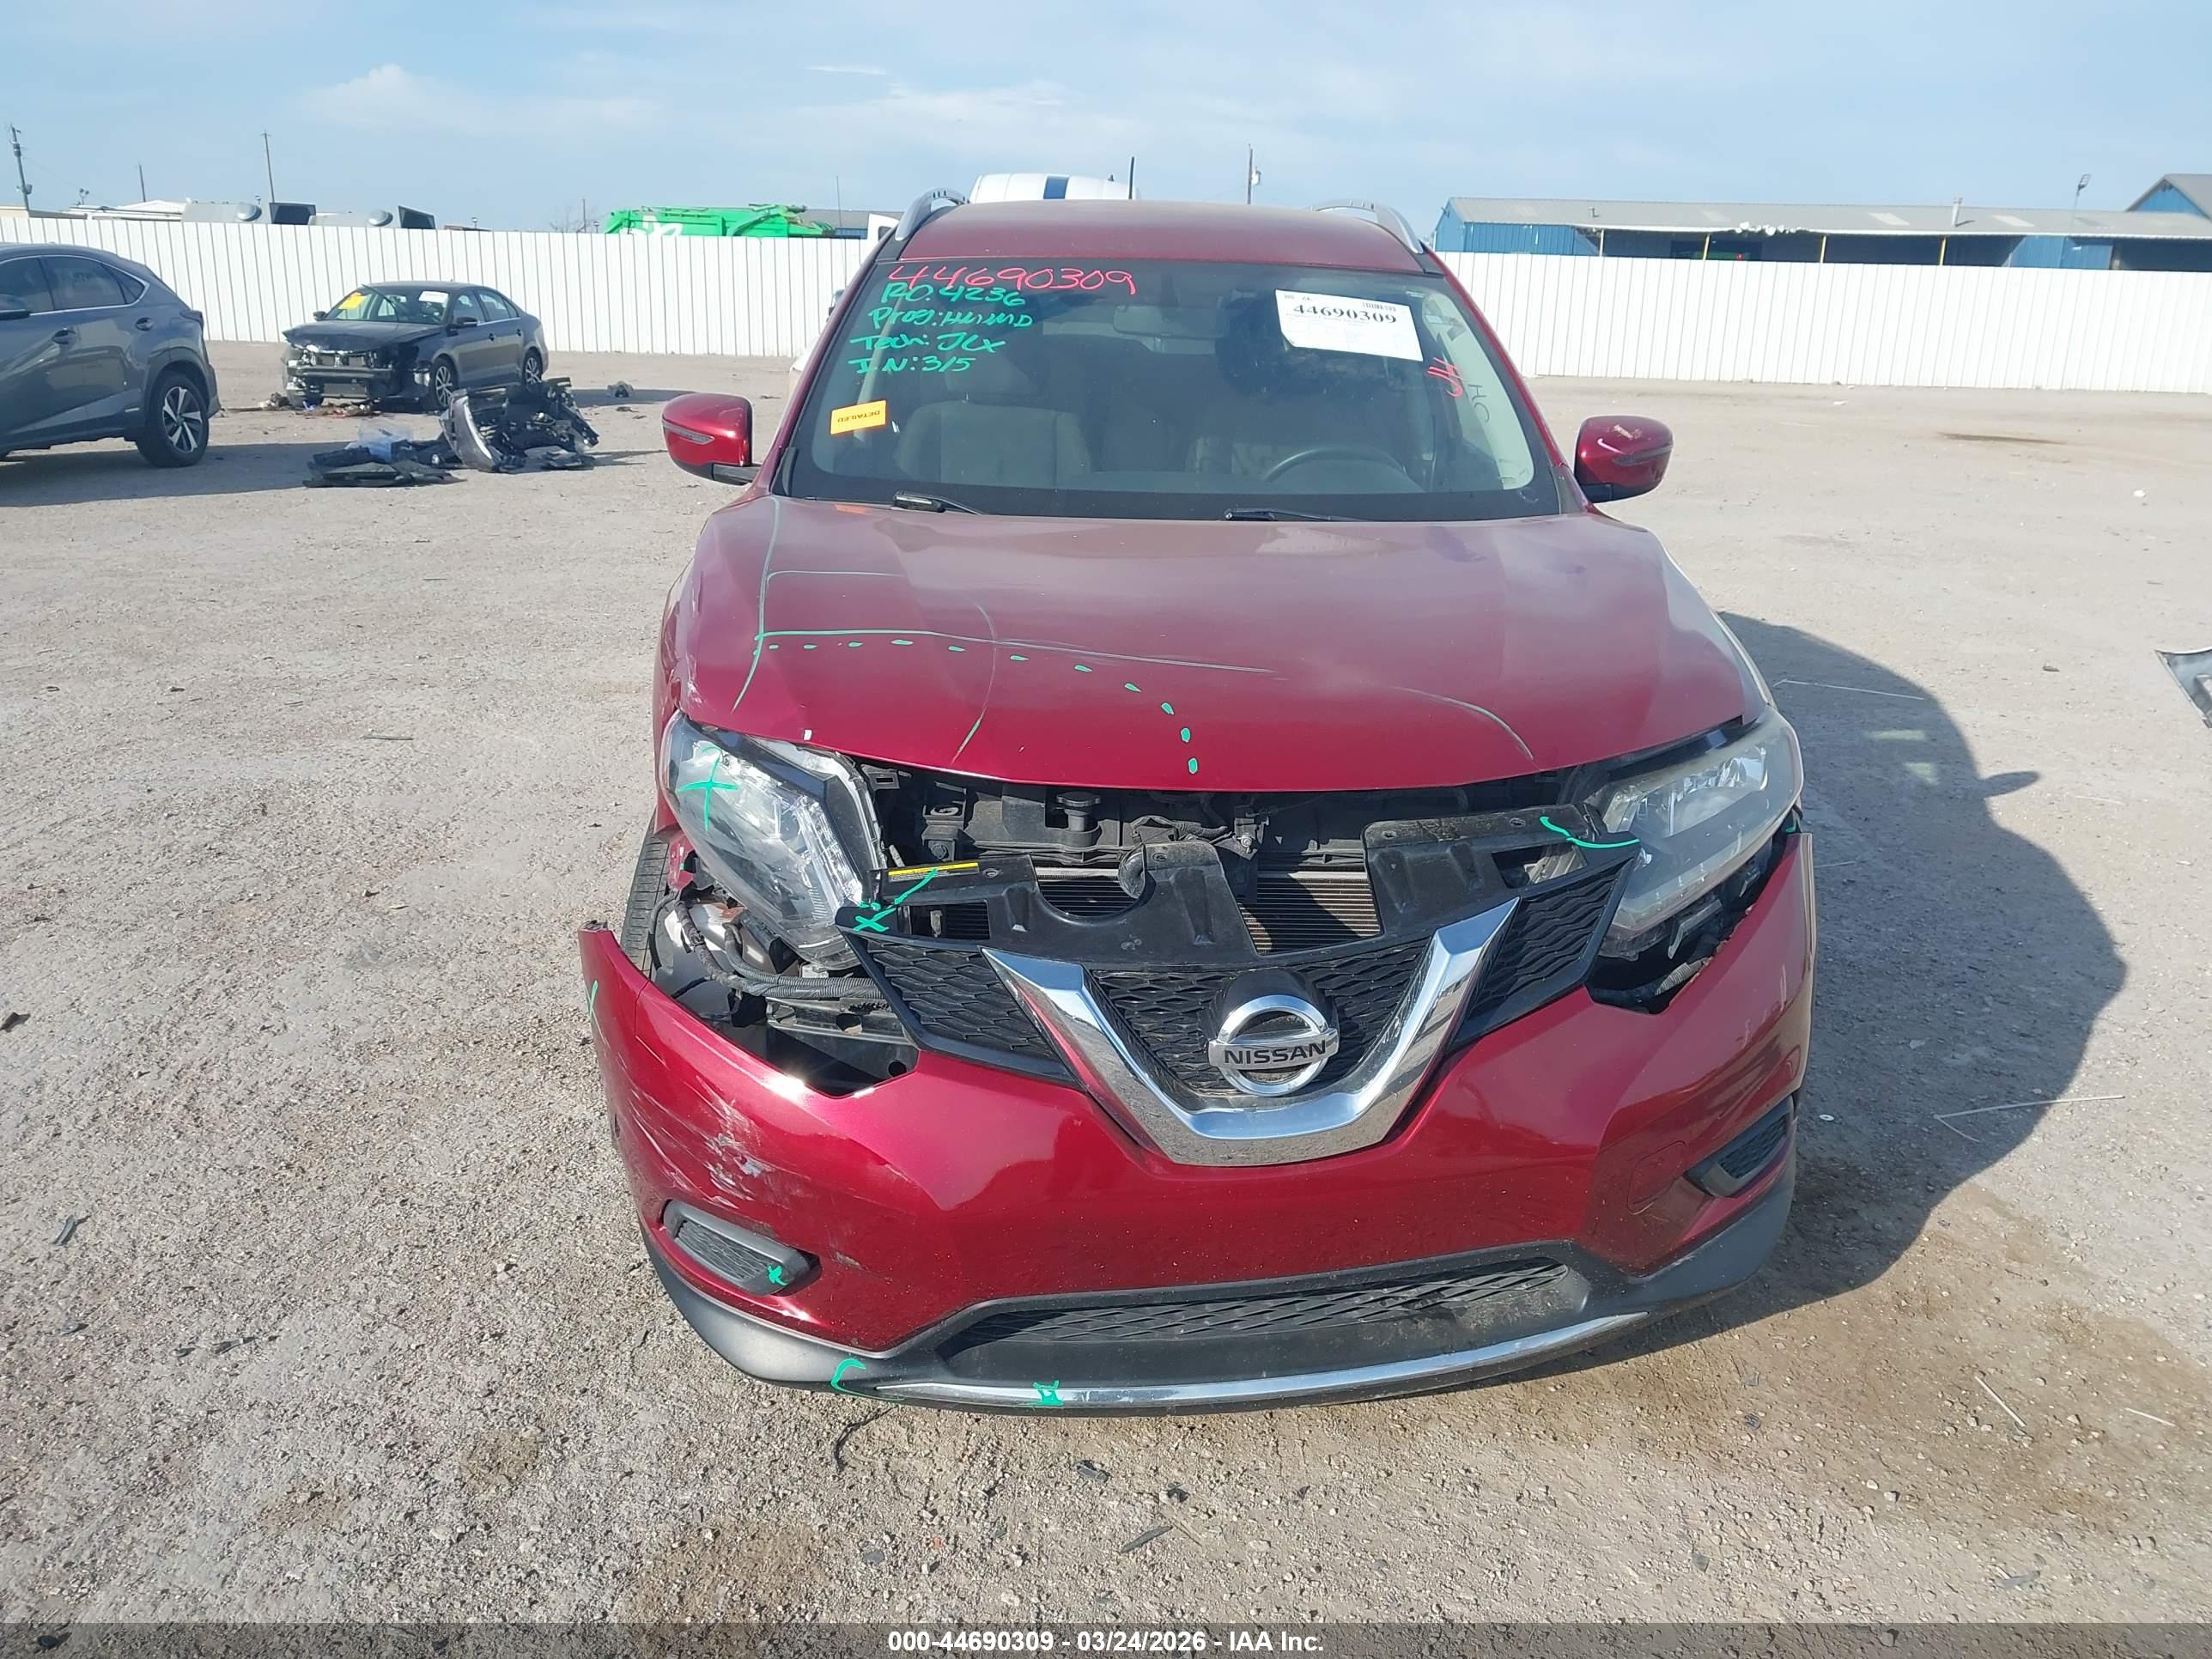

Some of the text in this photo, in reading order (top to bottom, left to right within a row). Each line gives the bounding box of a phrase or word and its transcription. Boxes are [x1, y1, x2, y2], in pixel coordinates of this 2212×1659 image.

[888, 265, 1138, 295] 44690309
[938, 285, 1026, 307] 4236
[1293, 304, 1397, 324] 44690309
[837, 410, 880, 422] DETAILED
[1224, 1040, 1327, 1065] NISSAN
